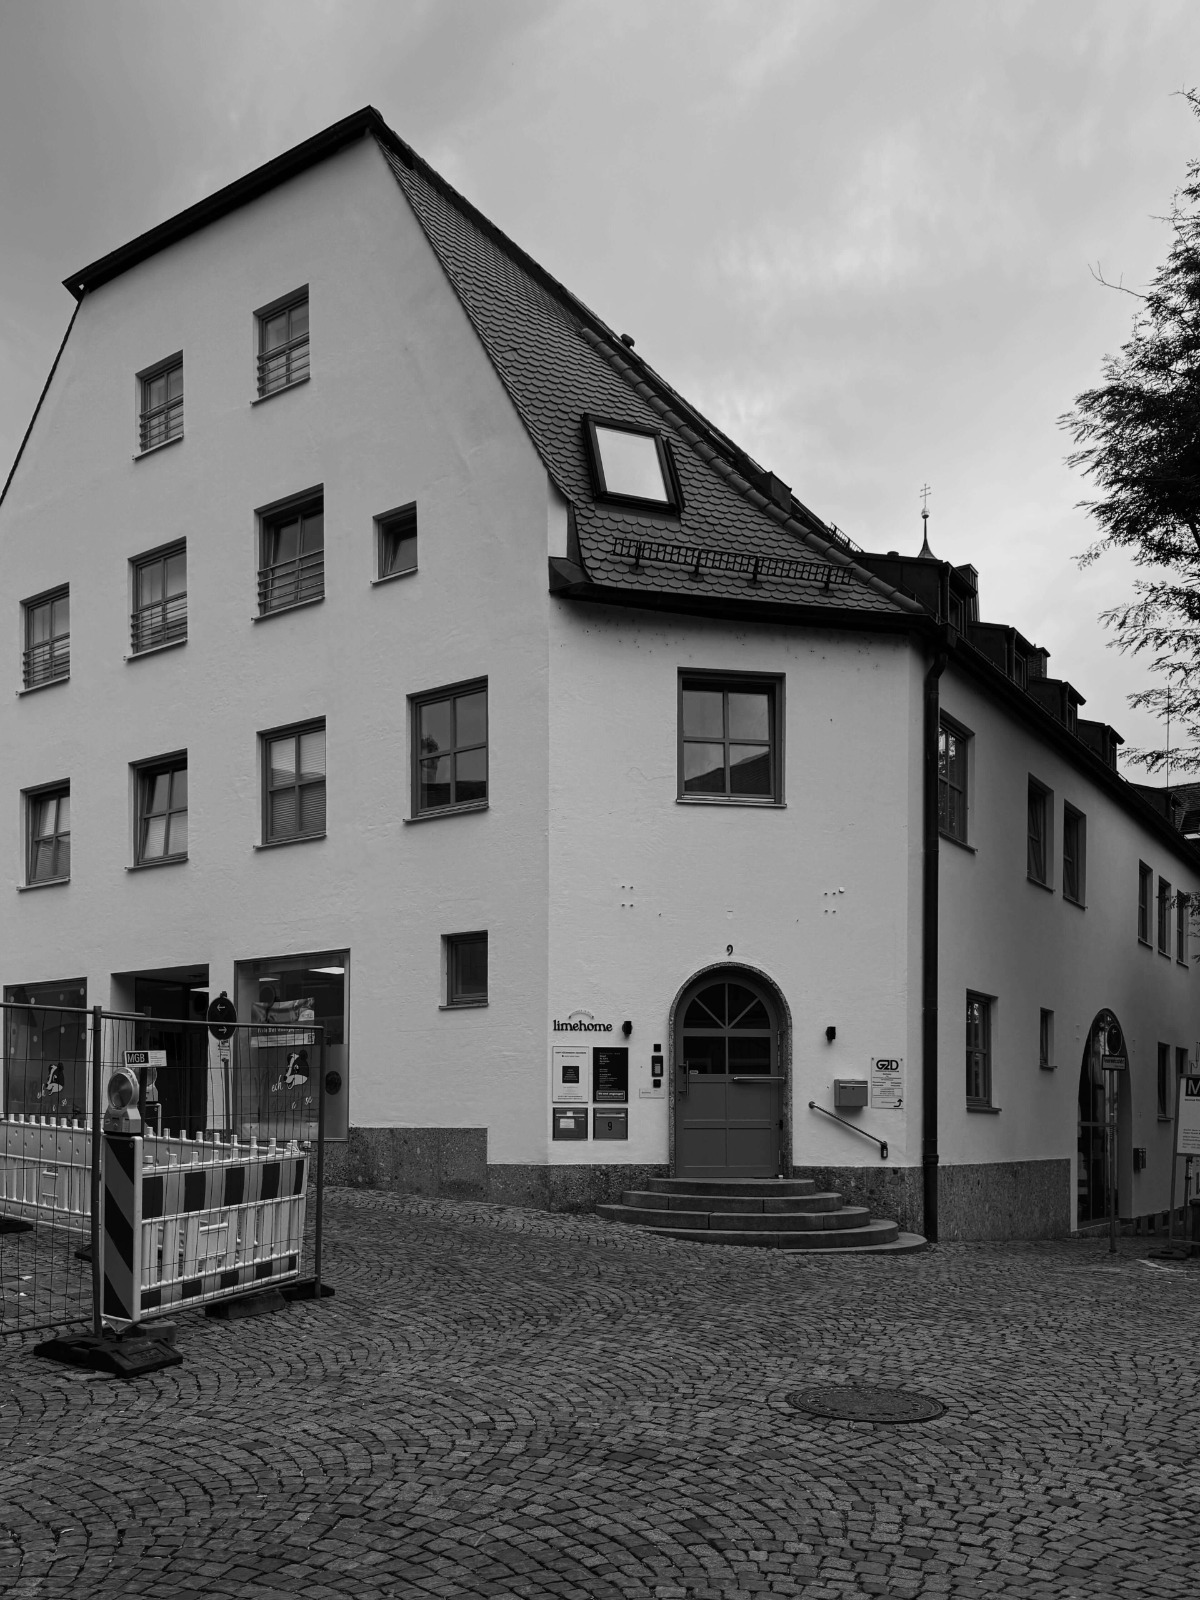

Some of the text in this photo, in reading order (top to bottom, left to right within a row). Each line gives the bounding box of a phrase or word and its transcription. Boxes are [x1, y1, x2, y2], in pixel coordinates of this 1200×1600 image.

[726, 944, 733, 956] 9
[552, 1019, 613, 1031] limehome
[127, 1053, 145, 1063] MGB
[607, 1121, 613, 1131] 9
